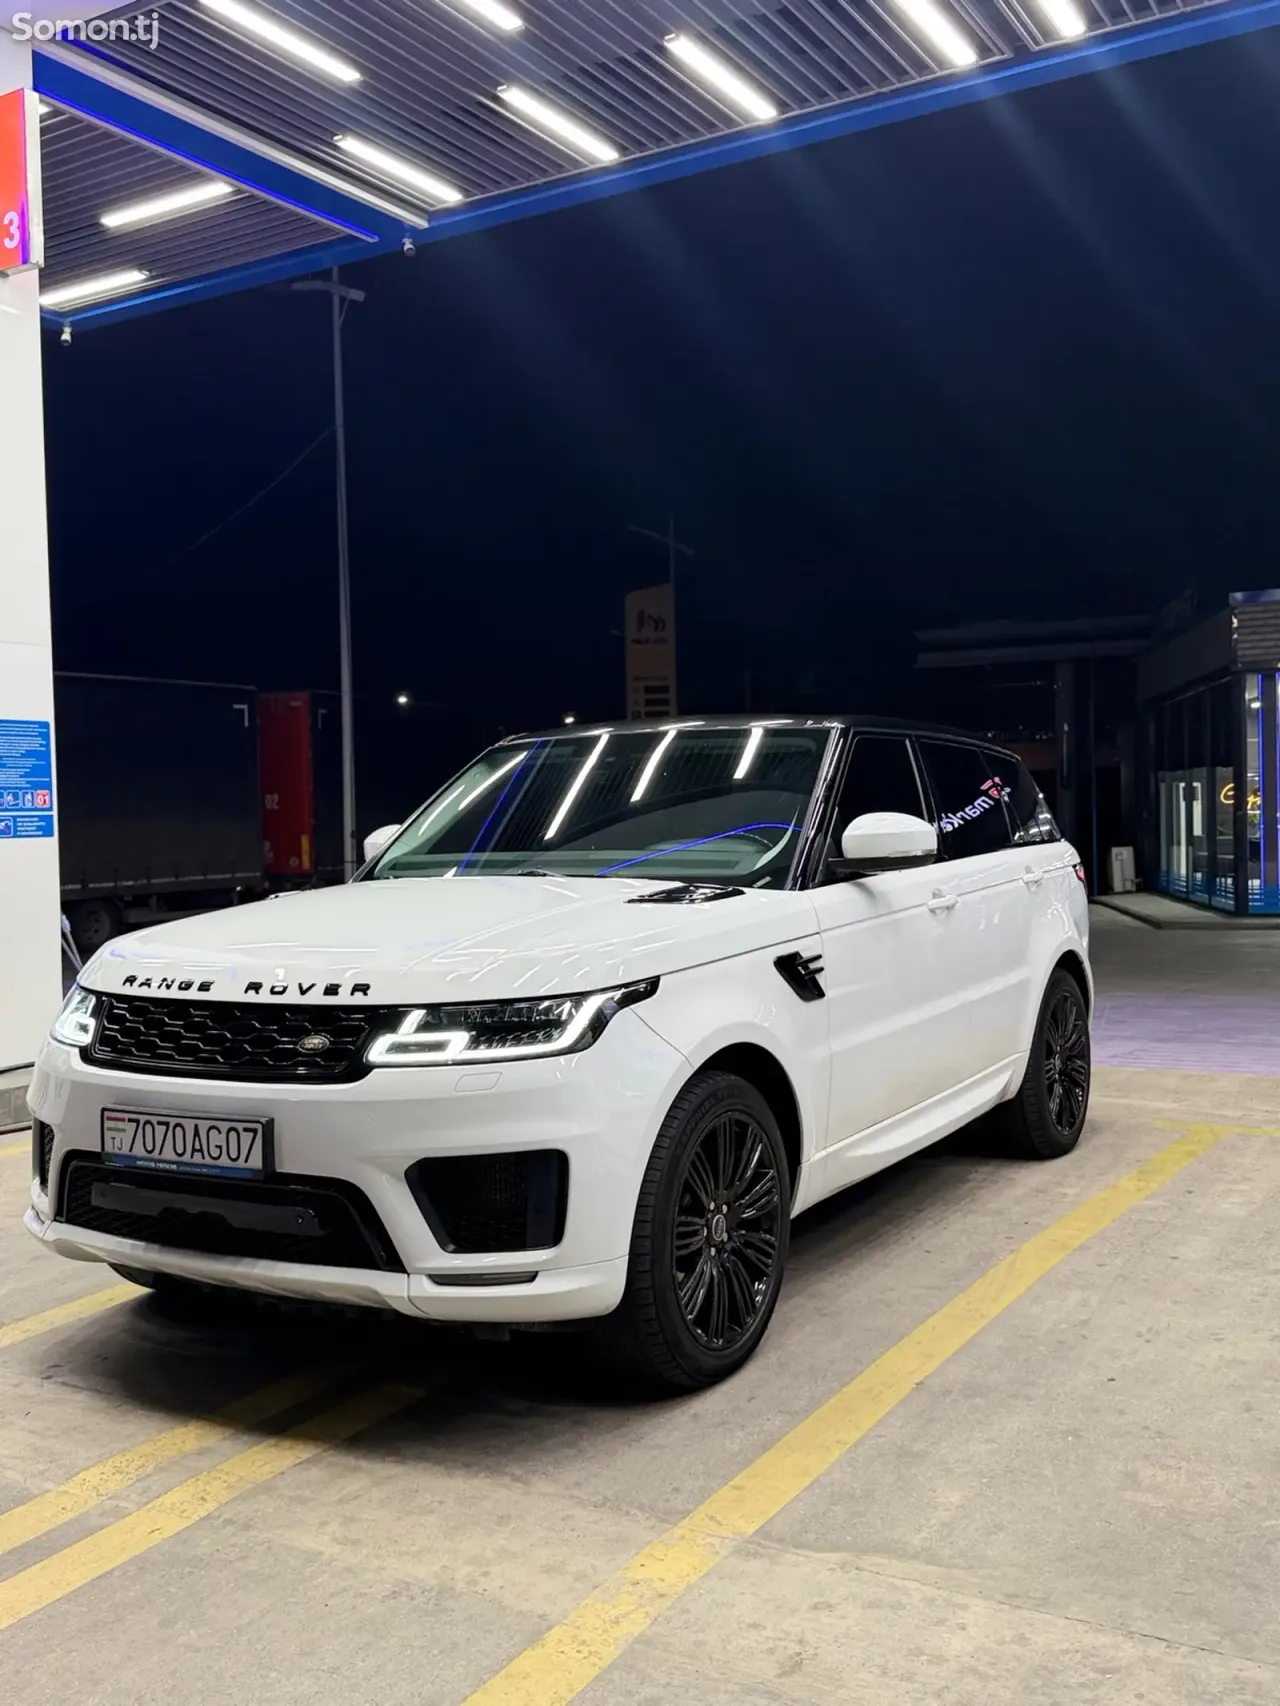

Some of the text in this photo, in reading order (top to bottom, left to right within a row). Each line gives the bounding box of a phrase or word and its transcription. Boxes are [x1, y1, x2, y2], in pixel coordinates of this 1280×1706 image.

[3, 211, 20, 249] 3
[122, 974, 372, 997] RANGE ROVER
[110, 1136, 124, 1151] TJ
[127, 1118, 259, 1164] 7070AG07
